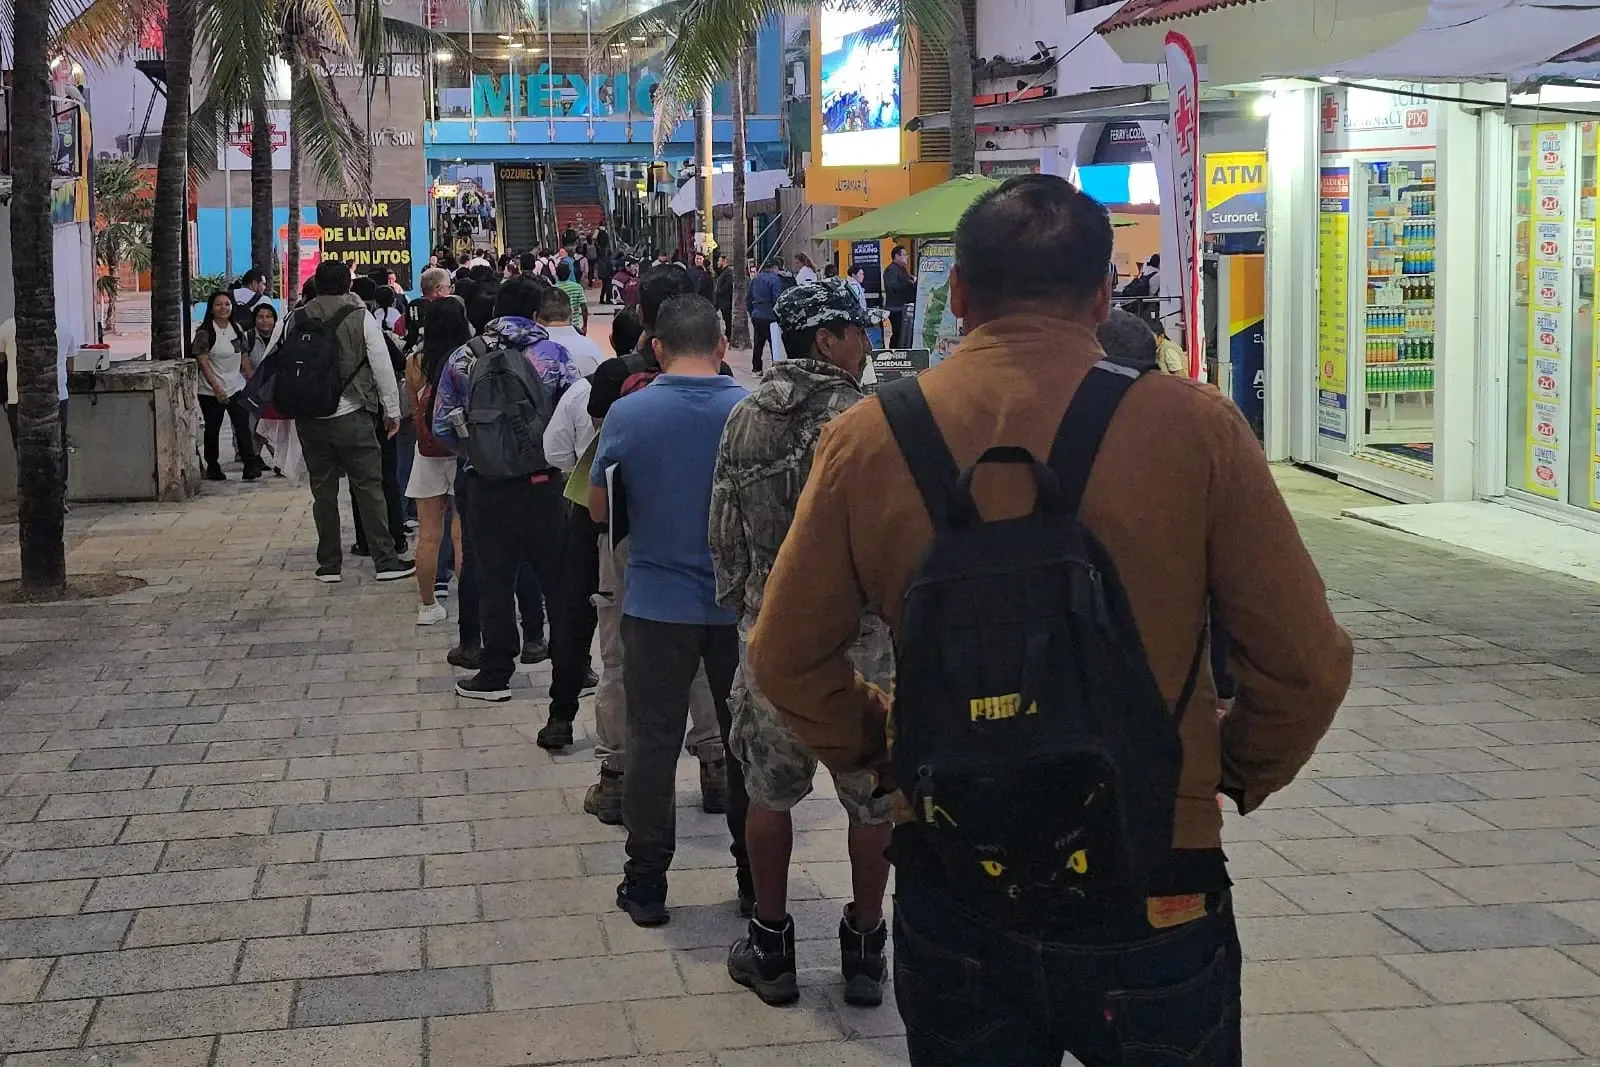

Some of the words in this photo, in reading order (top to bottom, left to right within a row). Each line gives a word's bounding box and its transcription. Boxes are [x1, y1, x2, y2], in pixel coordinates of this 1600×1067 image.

[474, 63, 733, 117] MÉXIC
[1407, 112, 1427, 126] PDC
[500, 167, 535, 180] COZUMEL
[1211, 165, 1263, 185] ATM
[1211, 212, 1261, 224] Euronet
[324, 226, 344, 242] DE
